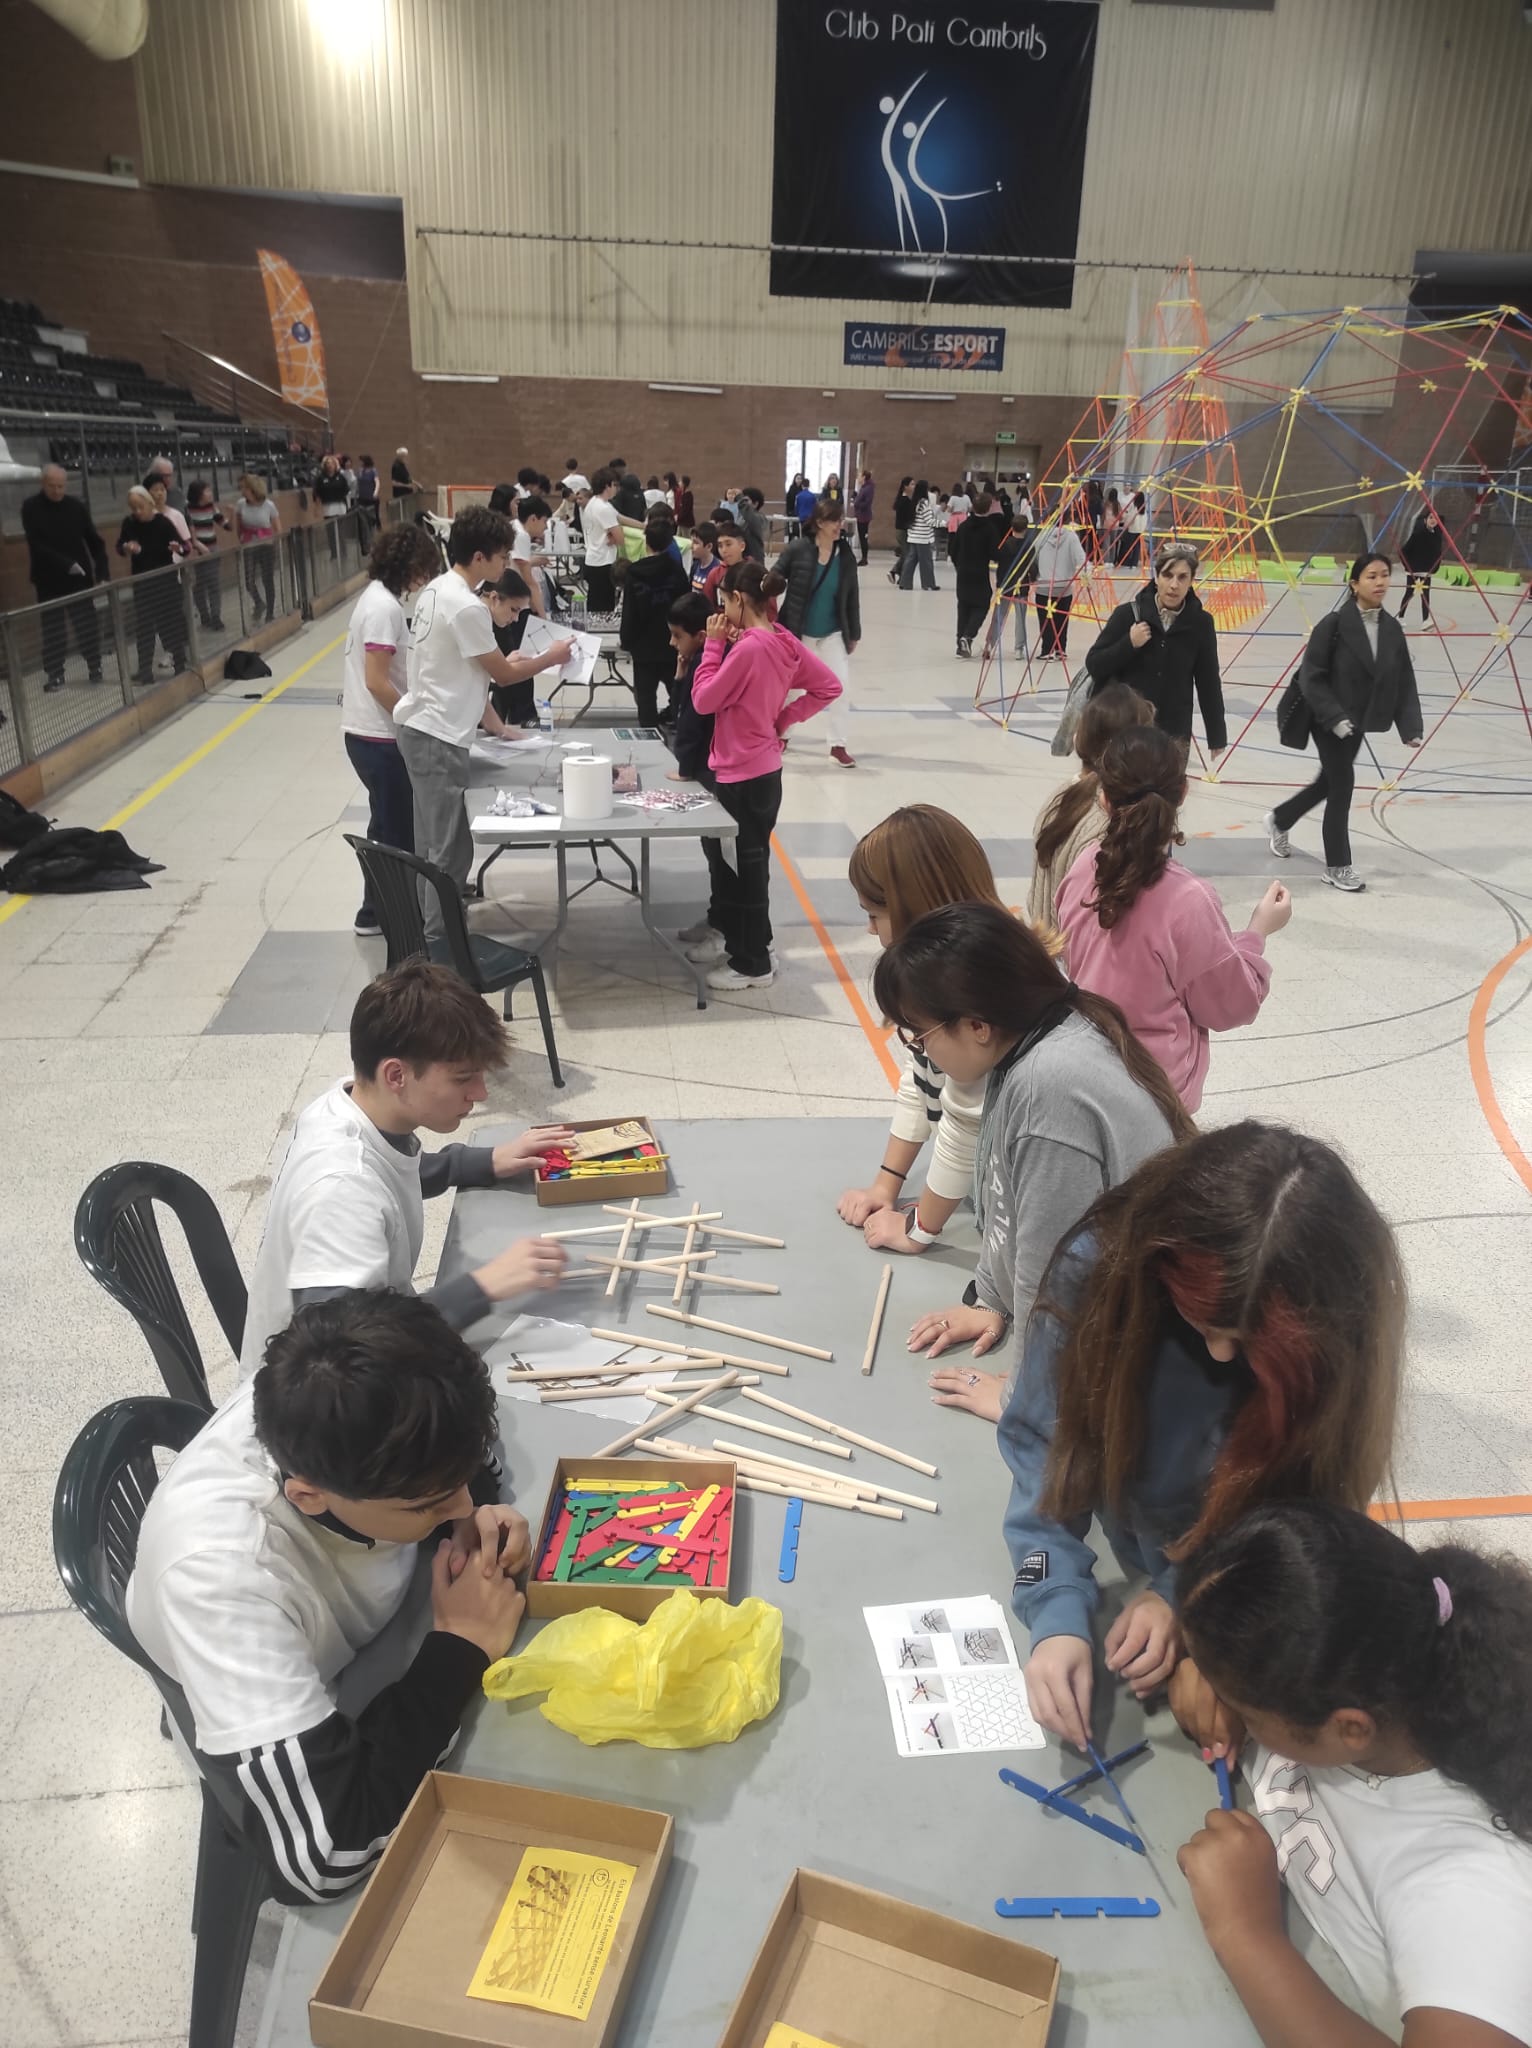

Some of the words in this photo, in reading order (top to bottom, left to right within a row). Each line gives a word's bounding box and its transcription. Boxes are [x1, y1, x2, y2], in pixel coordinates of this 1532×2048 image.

[825, 9, 879, 40] Club
[947, 17, 1047, 61] Cambrils
[851, 329, 929, 351] CAMBRILS
[934, 333, 999, 354] ESPORT
